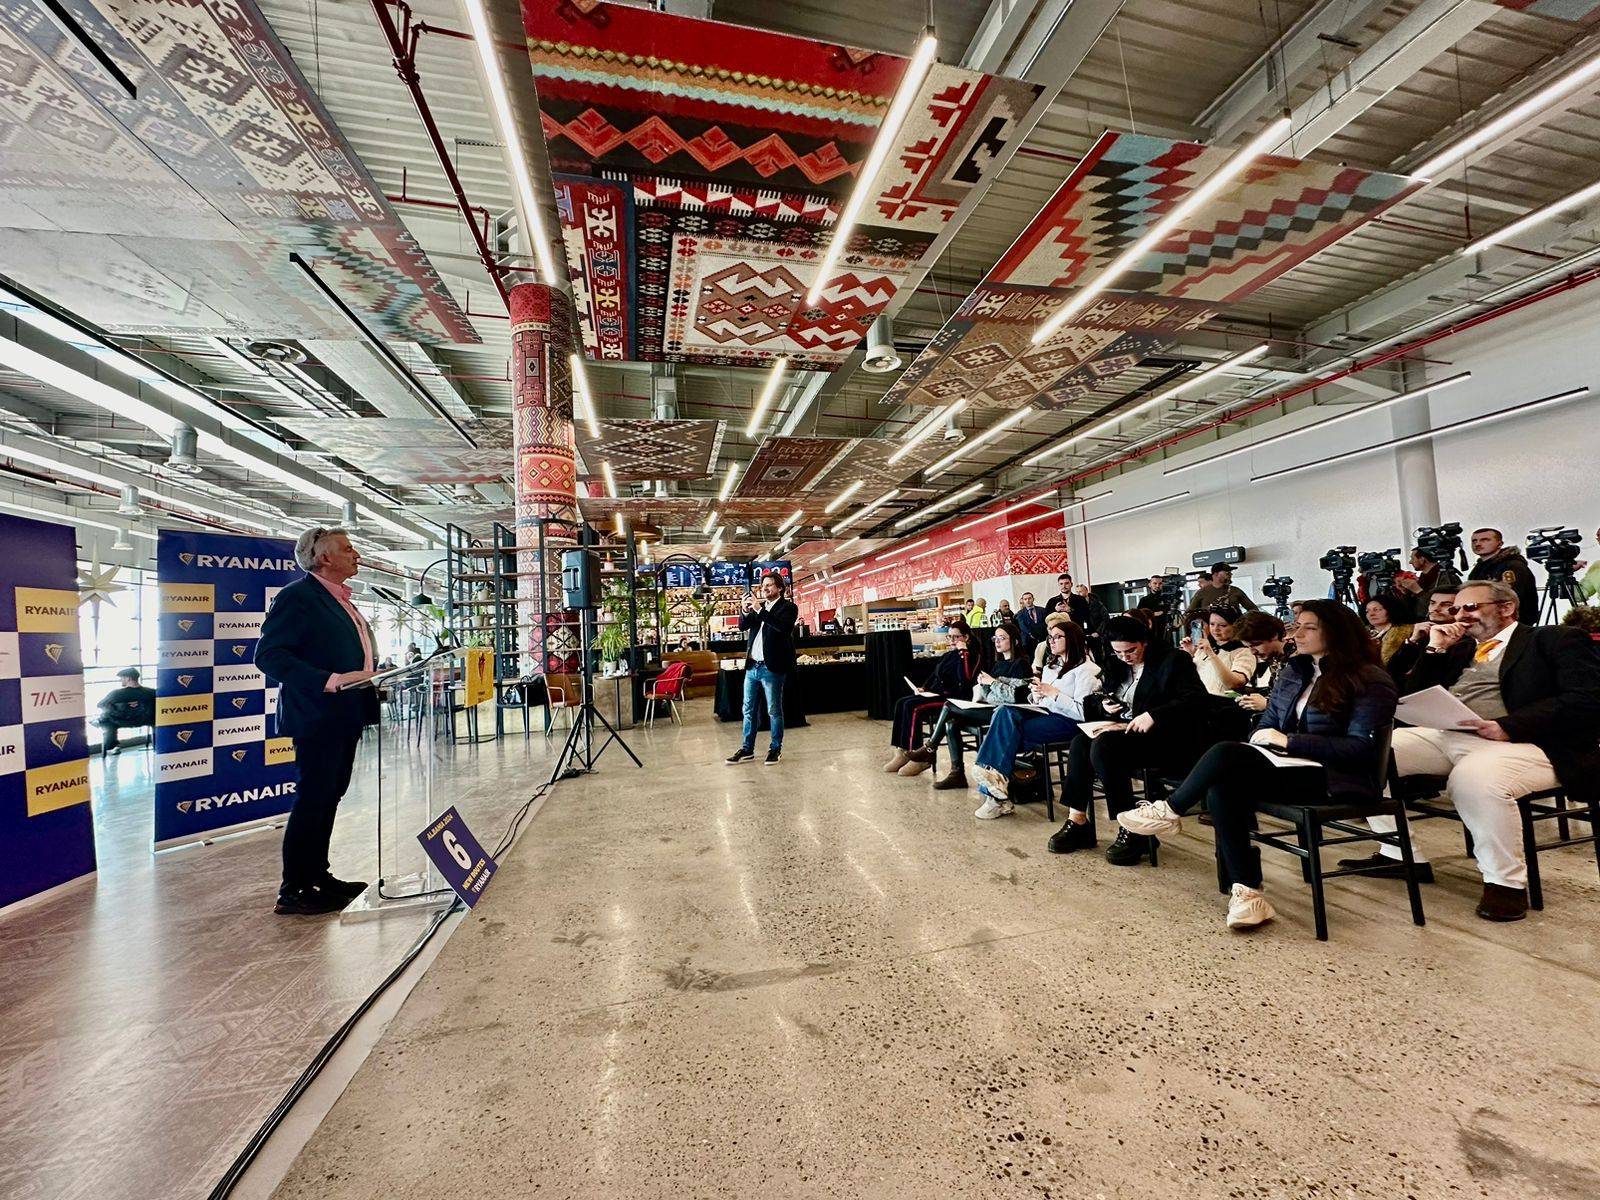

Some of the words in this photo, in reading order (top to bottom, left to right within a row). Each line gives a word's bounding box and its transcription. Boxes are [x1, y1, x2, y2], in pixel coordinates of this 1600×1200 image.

[197, 554, 296, 571] RYANAIR
[161, 650, 209, 658] RYANAIR
[218, 673, 261, 682] RYANAIR
[161, 704, 209, 715] RYANAIR
[217, 725, 261, 736] RYANAIR
[269, 746, 295, 754] RYAN
[160, 758, 208, 772] RYANAIR
[35, 775, 88, 796] RYANAIR
[195, 781, 297, 812] RYANAIR
[427, 821, 445, 840] ALBANIA
[442, 829, 472, 870] 6
[462, 877, 473, 890] NEW
[470, 858, 486, 879] ROUTES
[474, 868, 491, 892] RYANAIR
